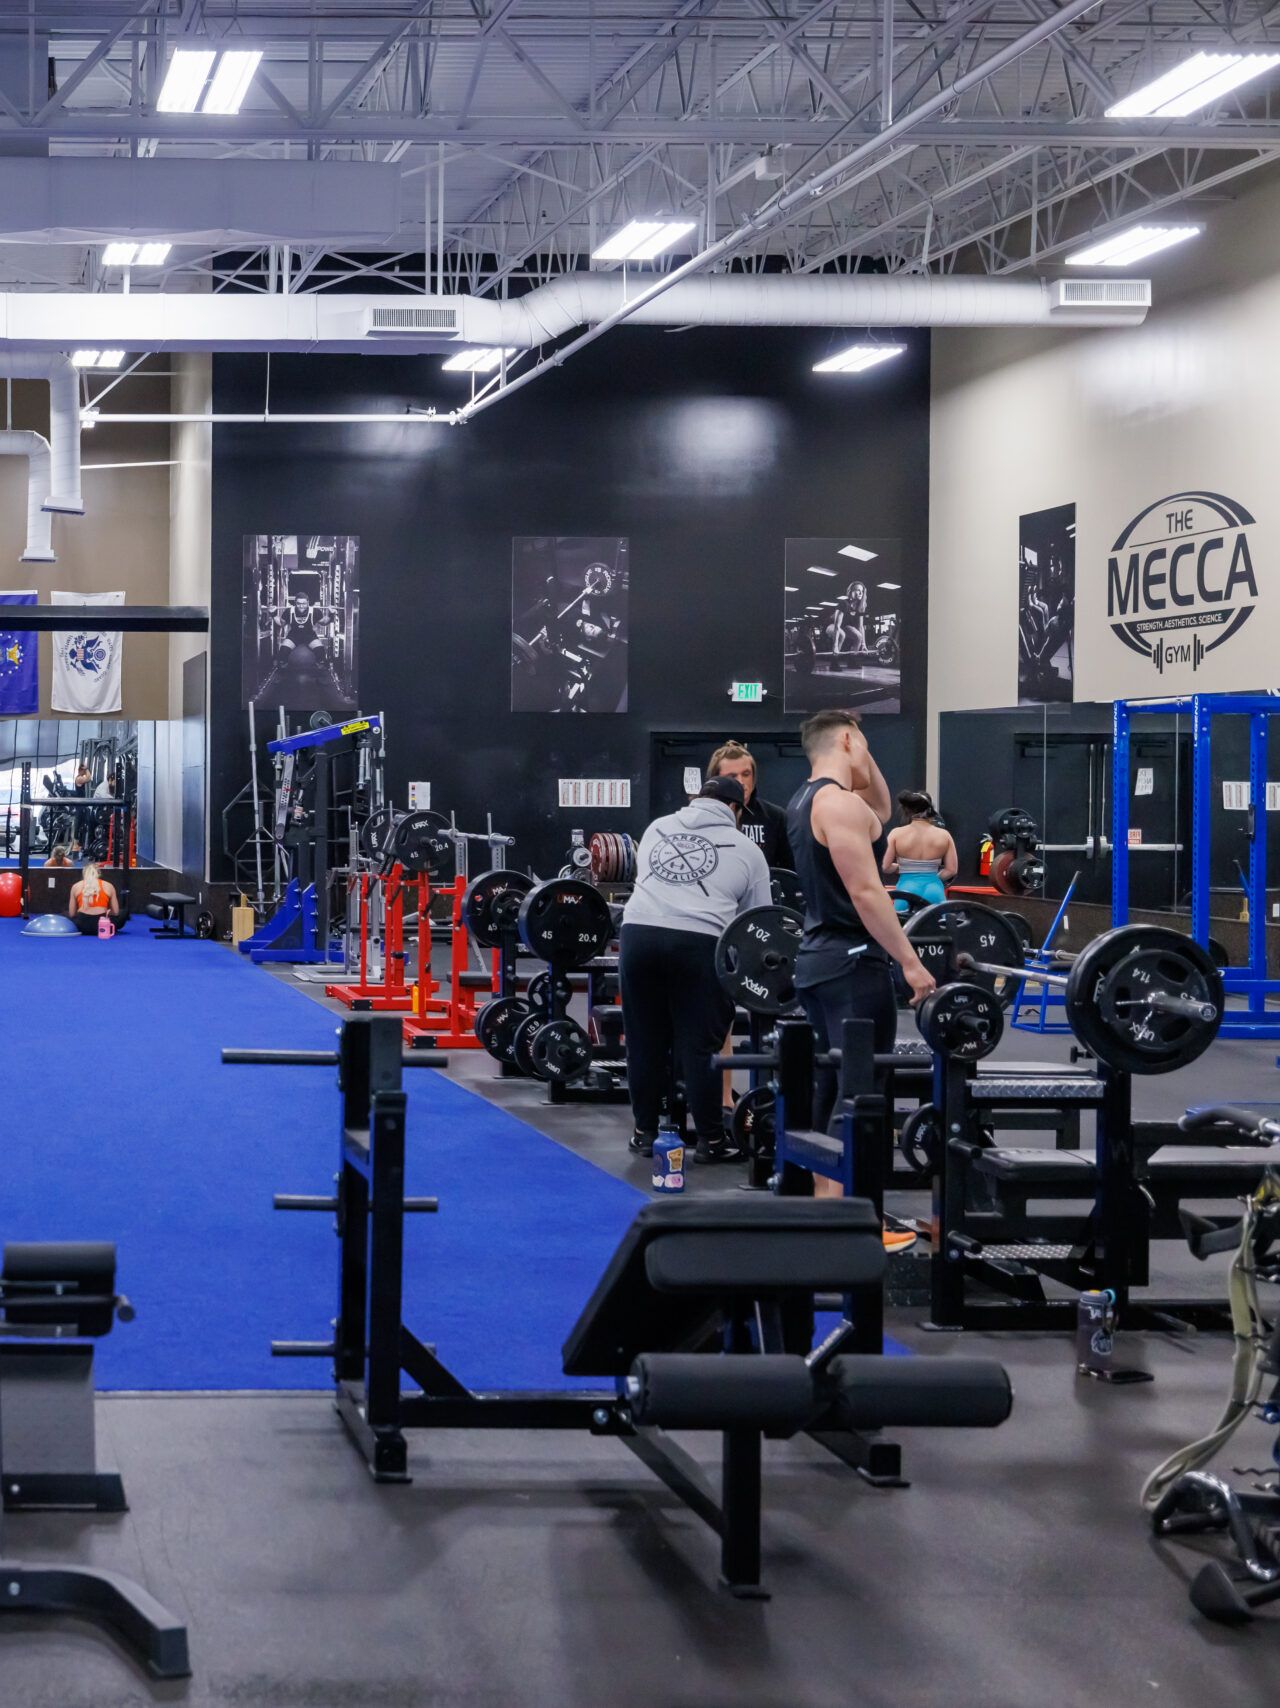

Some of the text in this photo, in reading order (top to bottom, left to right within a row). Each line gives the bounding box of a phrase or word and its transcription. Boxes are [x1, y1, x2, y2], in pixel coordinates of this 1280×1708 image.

[1166, 509, 1193, 534] THE
[1107, 533, 1258, 617] MECCA
[1136, 613, 1223, 632] STRENGTH. AESTHETICS. SCIENCE.
[1165, 644, 1191, 664] GYM
[738, 684, 759, 699] EXIT
[434, 843, 449, 851] 20.4
[666, 834, 713, 853] ARBELL
[410, 851, 419, 859] 45
[650, 861, 706, 881] BATTALION
[488, 923, 497, 932] 45
[747, 923, 771, 942] 20.4
[541, 930, 553, 940] 45
[578, 933, 597, 943] 20.4
[980, 934, 996, 948] 45
[1132, 967, 1151, 983] 11.4
[741, 976, 769, 999] UMAX
[978, 1003, 989, 1013] 10
[938, 1012, 952, 1022] 4.5
[550, 1030, 561, 1041] 11.4
[576, 1047, 587, 1057] 25
